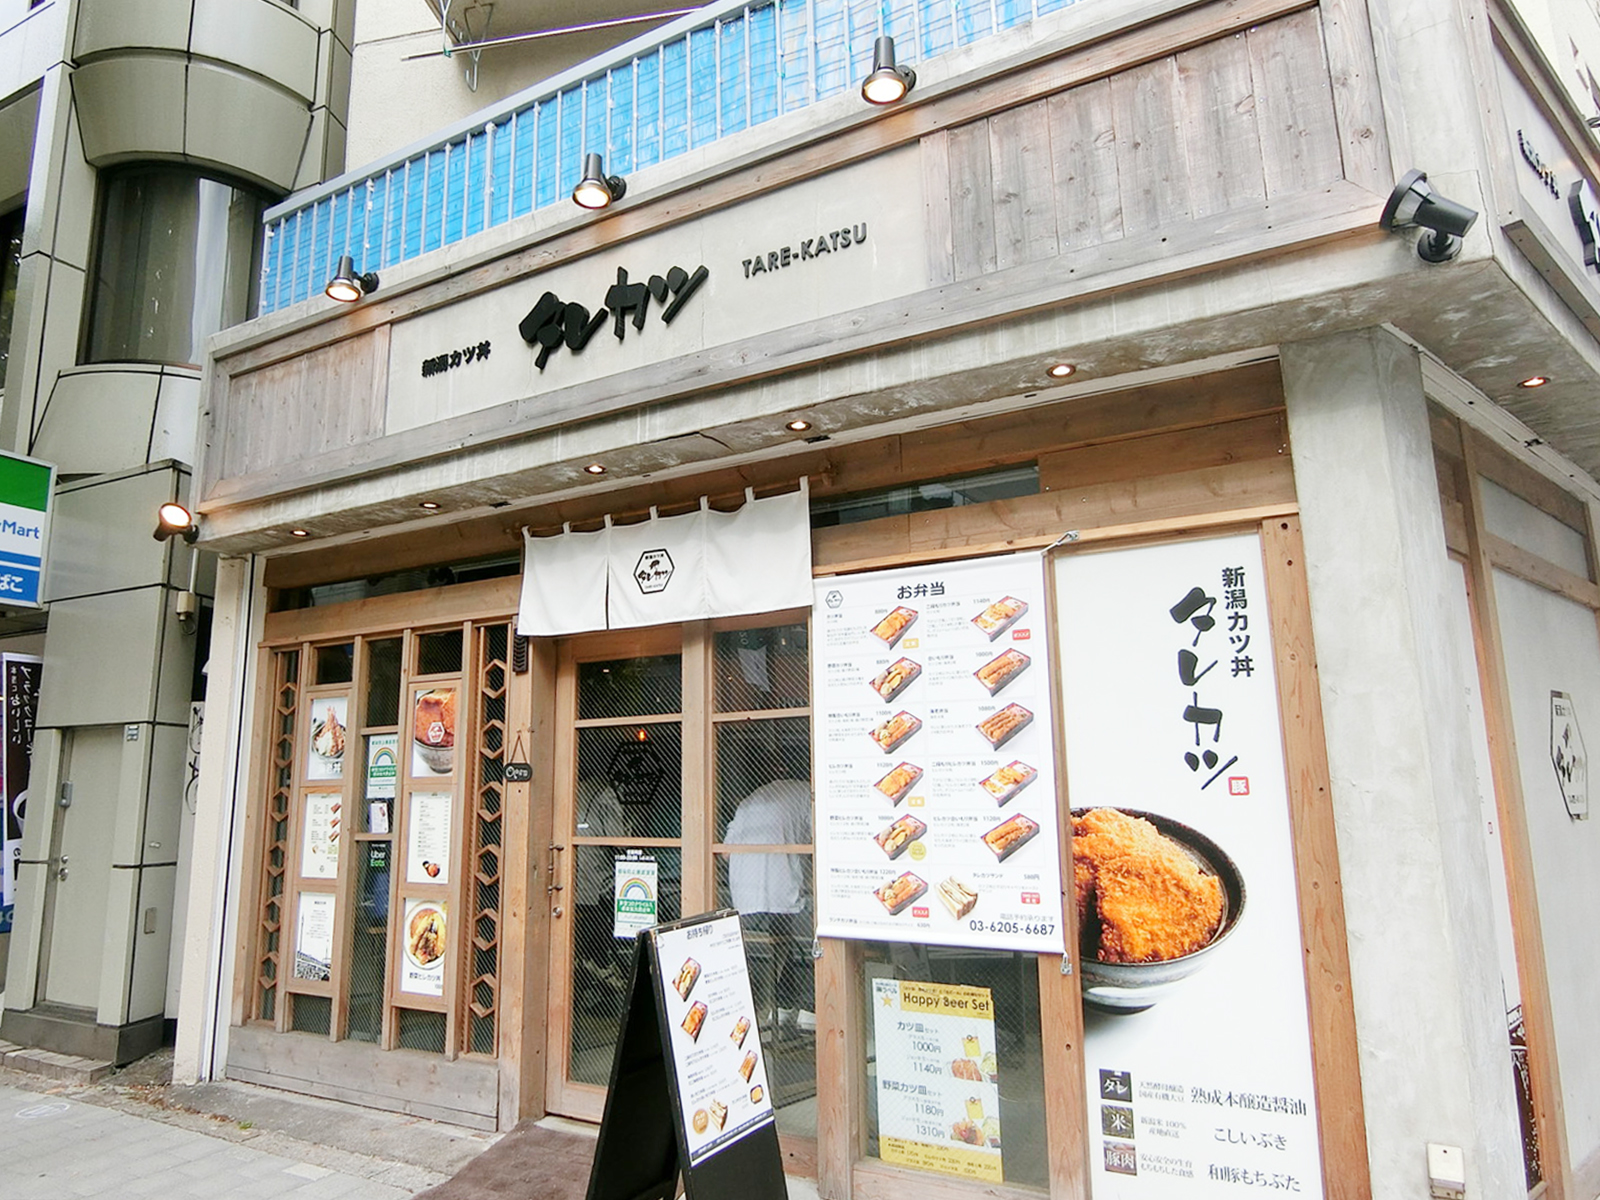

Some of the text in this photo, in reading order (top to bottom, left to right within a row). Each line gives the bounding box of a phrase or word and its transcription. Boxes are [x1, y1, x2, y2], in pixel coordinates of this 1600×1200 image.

[742, 221, 868, 278] TARE-KATSU
[519, 265, 709, 371] タレカツ
[421, 339, 491, 378] 新潟カツ丼
[0, 519, 39, 540] Mart
[896, 580, 945, 600] お弁当
[1221, 565, 1255, 678] 新潟カツ丼
[1169, 586, 1238, 791] タレカツ
[371, 850, 386, 859] Uber
[969, 920, 1055, 936] 03-6205-6687
[903, 993, 990, 1011] Happy Beer Set
[912, 1041, 941, 1054] 1000円
[912, 1062, 942, 1075] 1140円
[1103, 1079, 1129, 1094] タレ
[914, 1103, 944, 1117] 1180円
[1190, 1086, 1308, 1117] 熟成本醸造醤油
[915, 1124, 945, 1139] 1310円
[1110, 1113, 1127, 1130] 米
[1213, 1128, 1288, 1151] こしいぶき
[1105, 1150, 1135, 1170] 豚肉
[1207, 1164, 1301, 1193] 和豚もちぶた
